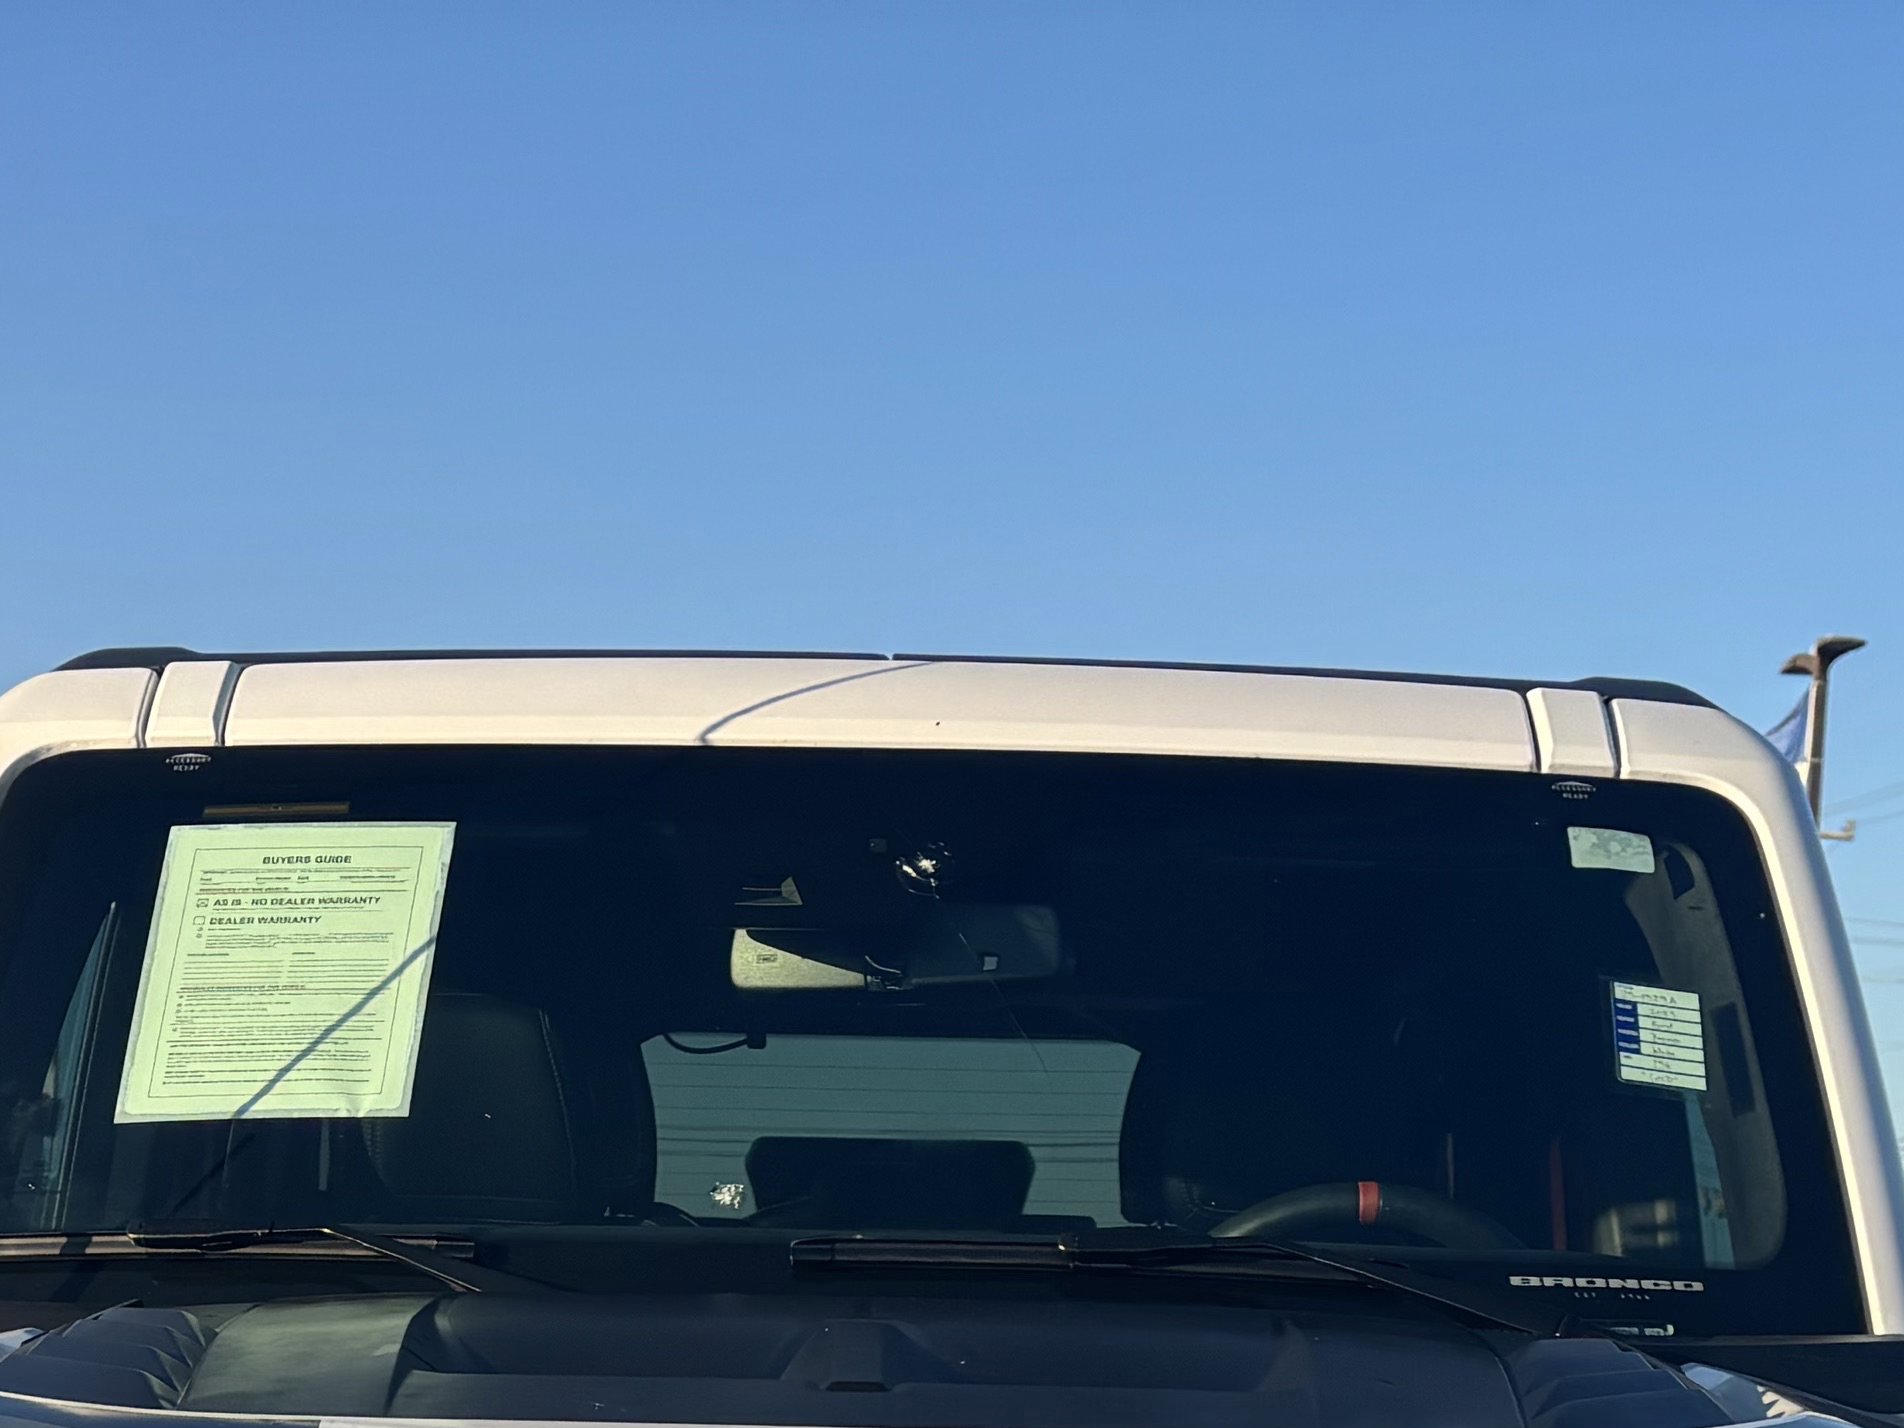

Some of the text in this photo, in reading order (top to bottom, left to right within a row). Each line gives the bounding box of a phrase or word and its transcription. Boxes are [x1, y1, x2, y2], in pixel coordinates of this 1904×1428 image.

[262, 854, 352, 865] BUYERS GUIDE
[270, 897, 316, 906] DEALER
[208, 916, 255, 926] DEALER
[1508, 1275, 1705, 1292] BRONCO
